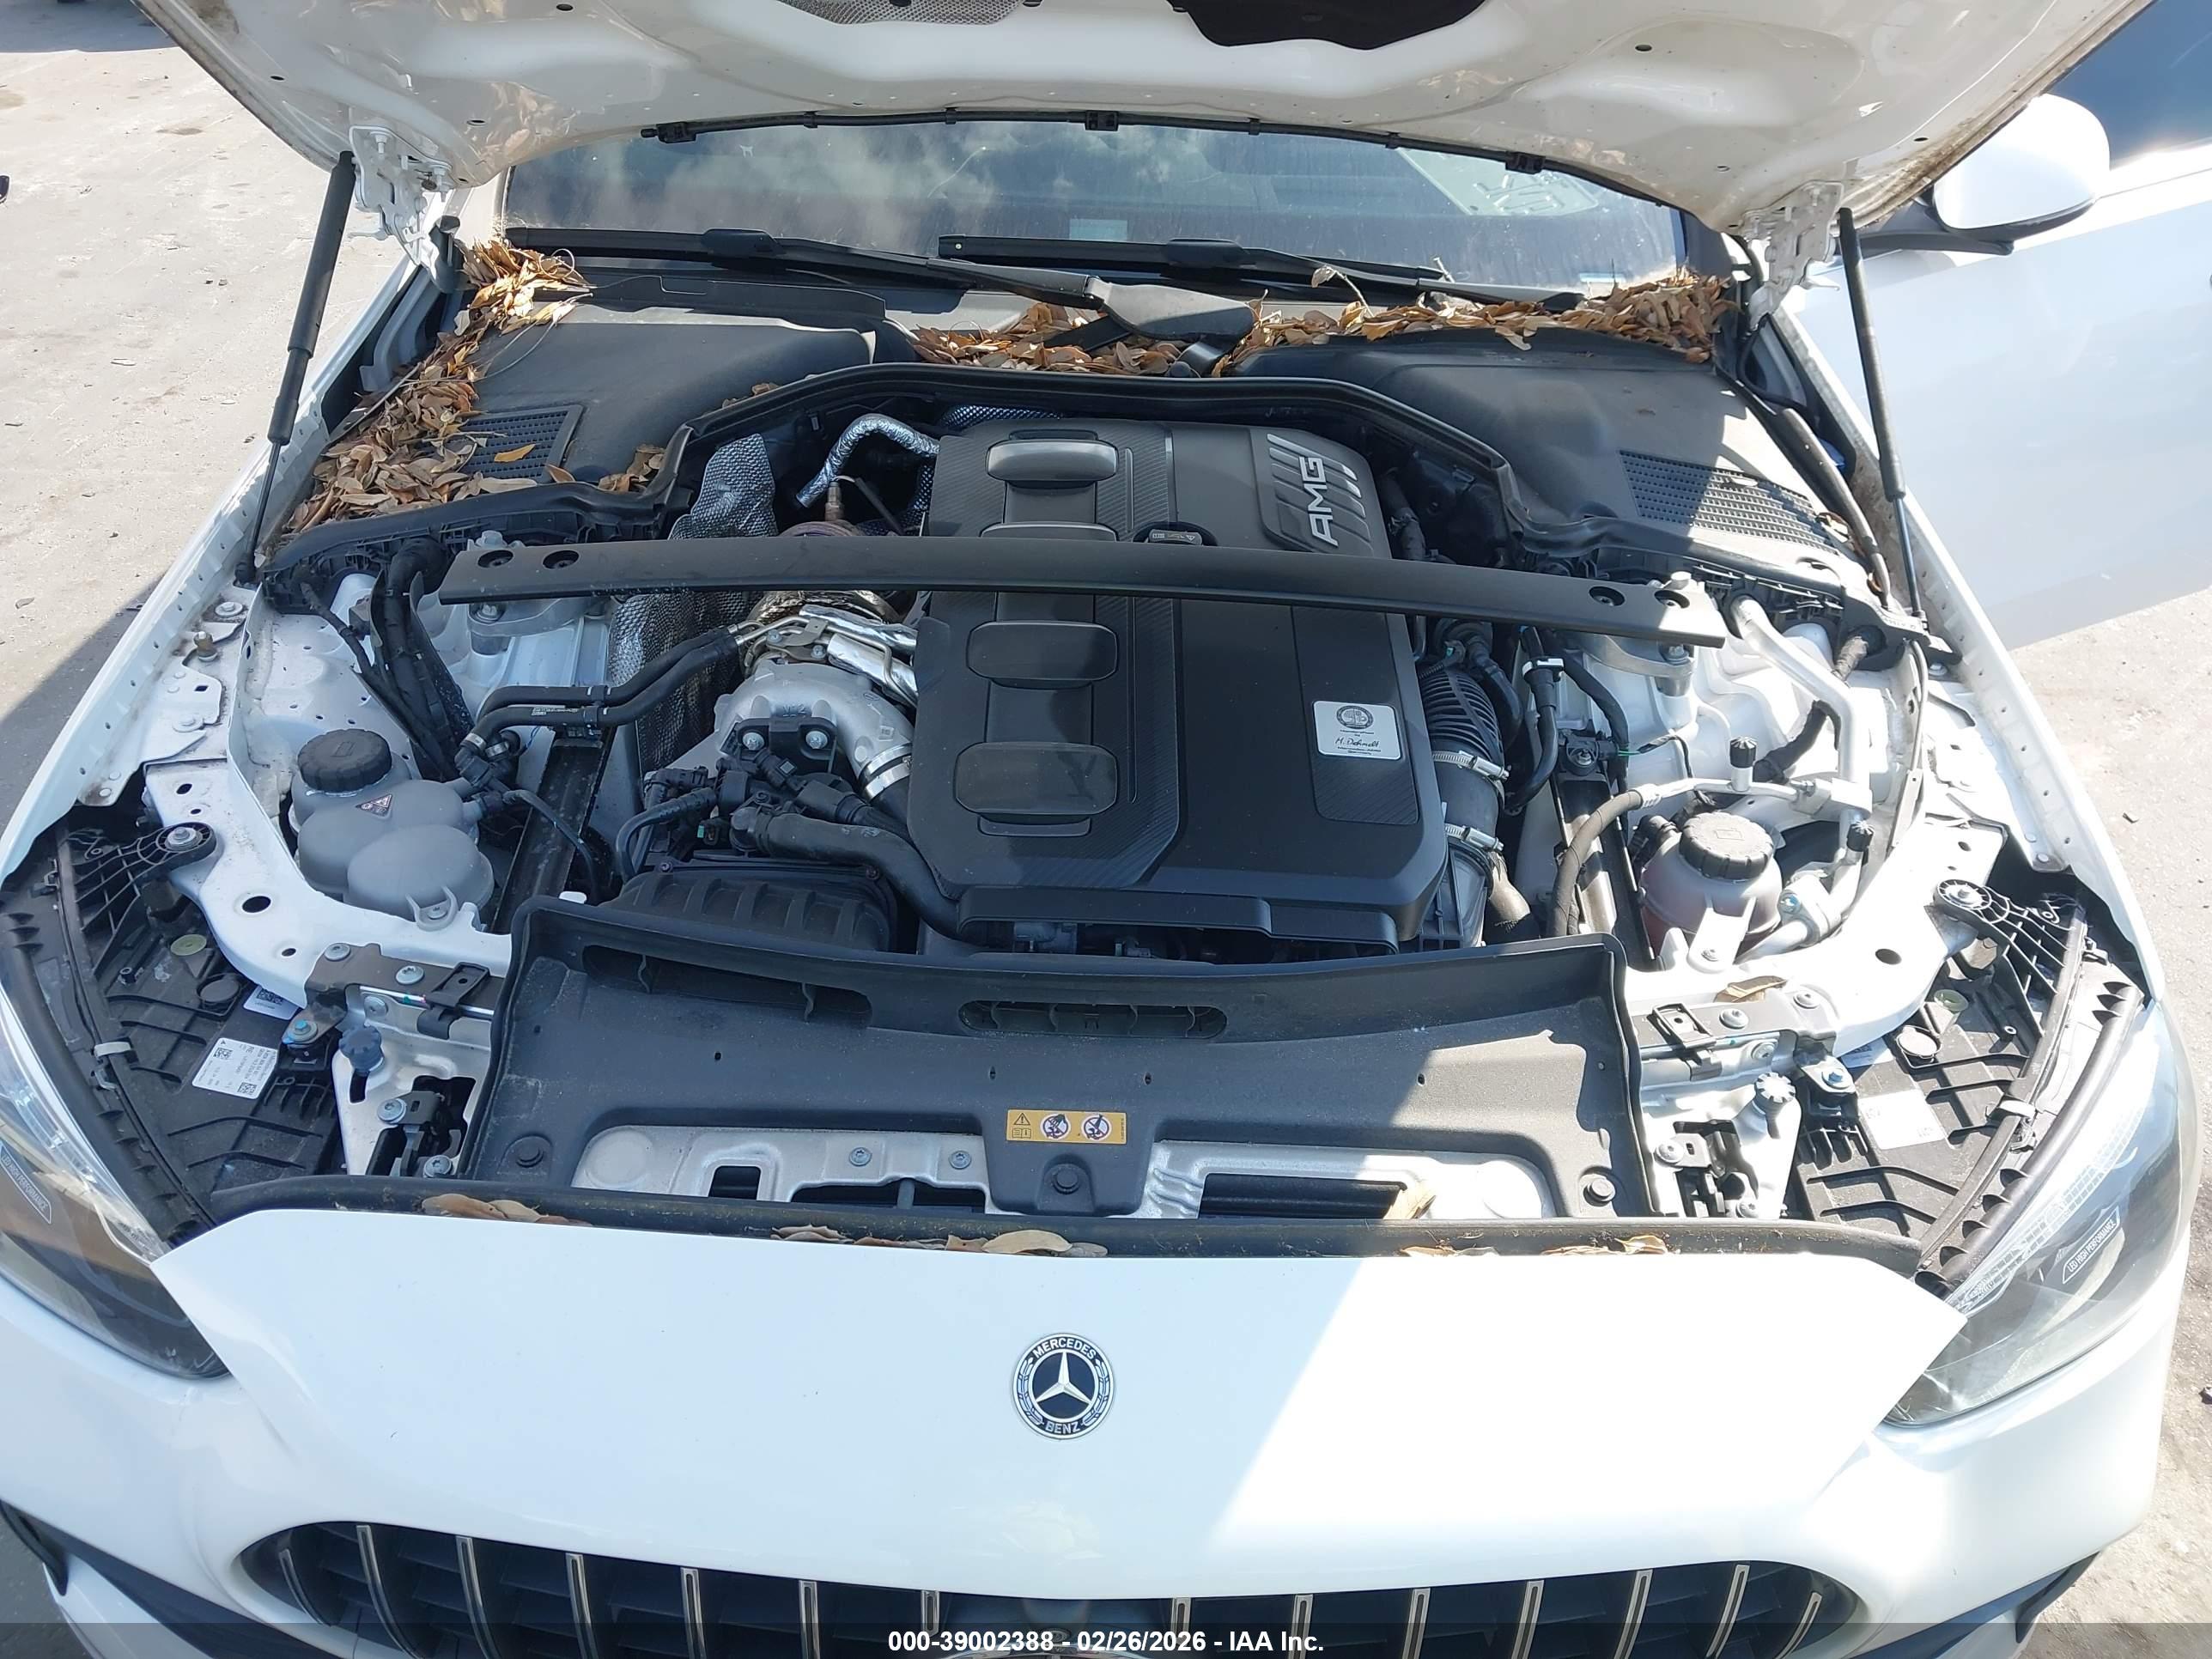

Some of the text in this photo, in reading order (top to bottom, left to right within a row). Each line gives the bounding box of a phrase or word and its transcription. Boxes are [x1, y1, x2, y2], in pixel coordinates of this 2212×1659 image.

[1298, 456, 1339, 547] AMG
[17, 1175, 48, 1211] PERFORMANCE
[2067, 1219, 2116, 1273] LED HIGH PERFORMANCE
[1031, 1337, 1097, 1360] MERCEDES
[1045, 1421, 1081, 1434] BENZ
